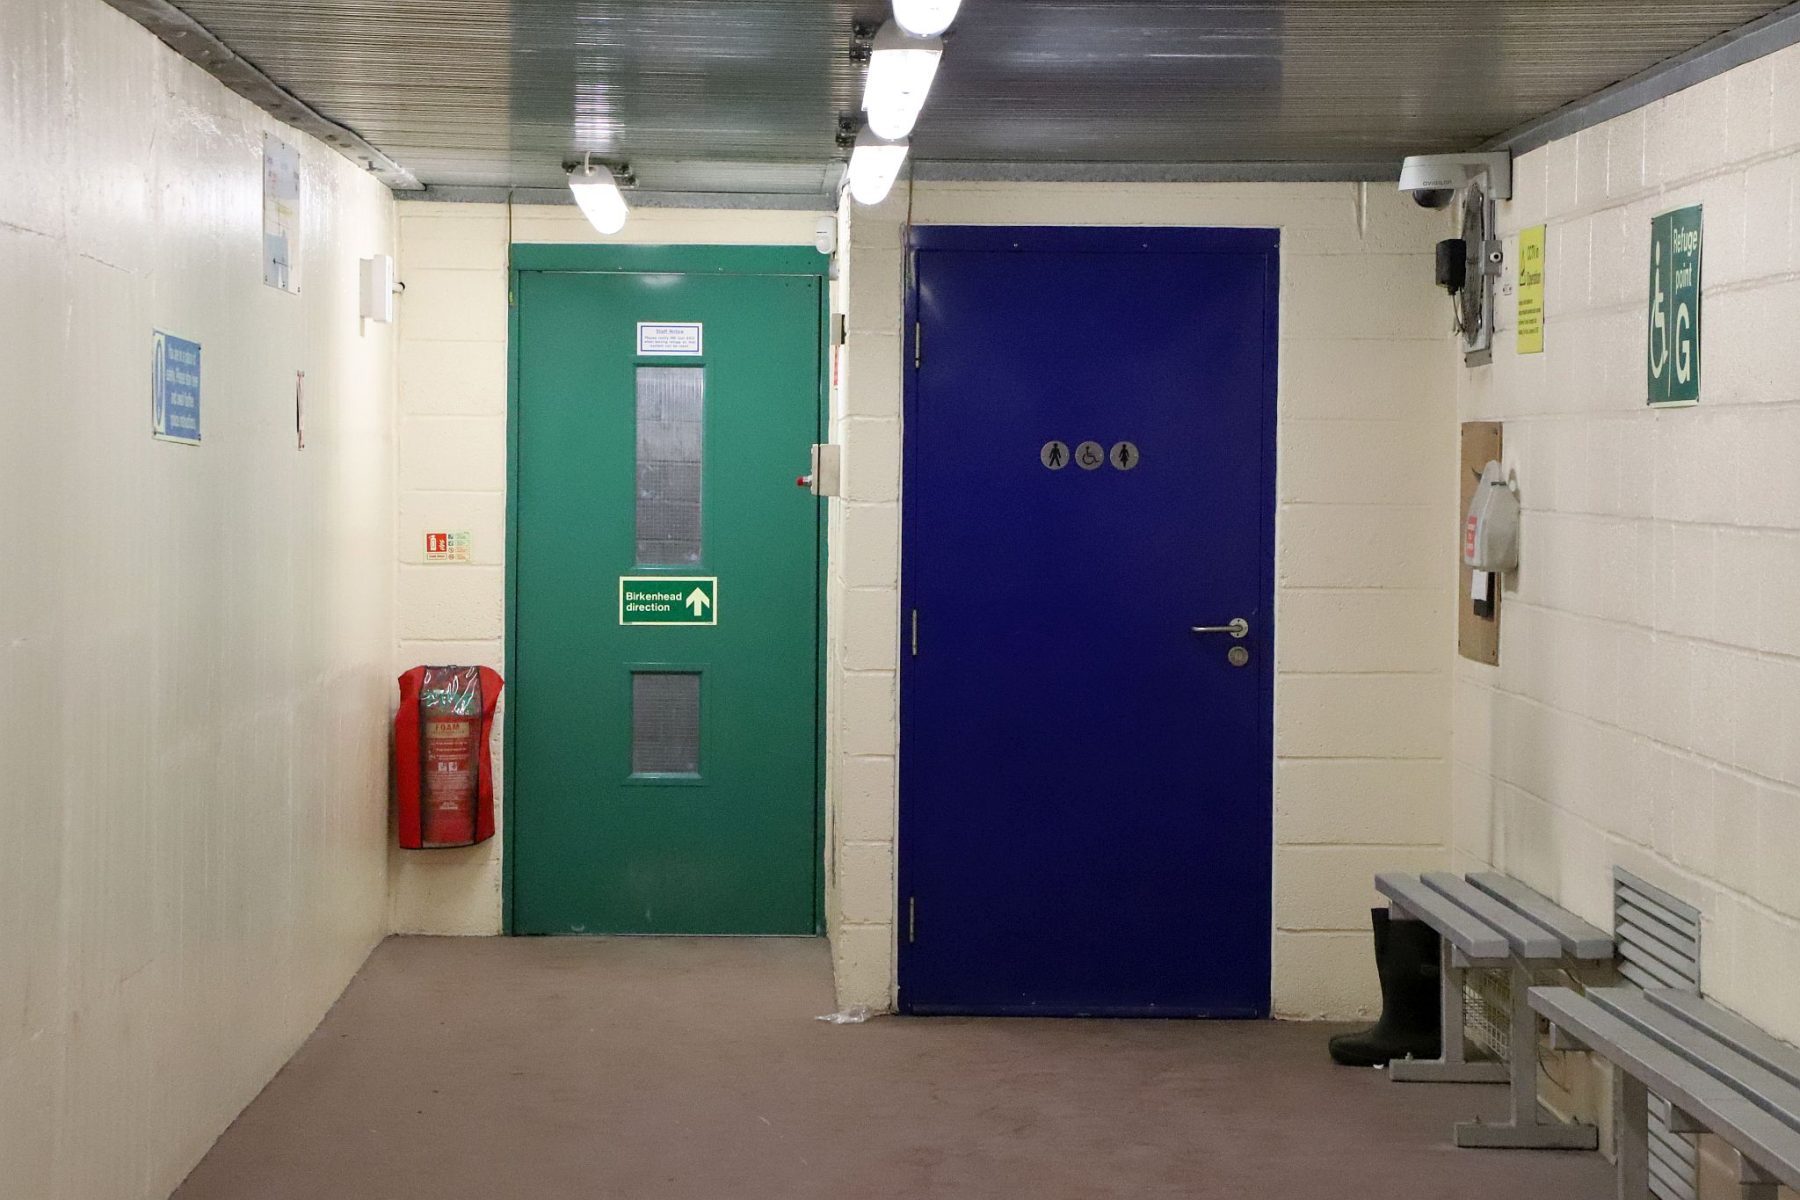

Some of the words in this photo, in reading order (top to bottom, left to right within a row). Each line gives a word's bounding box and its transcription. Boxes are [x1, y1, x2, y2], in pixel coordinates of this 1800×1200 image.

[1673, 228, 1698, 256] Refuge
[1675, 263, 1692, 294] point
[1676, 303, 1690, 384] G
[625, 592, 682, 601] Birkenhead
[626, 603, 670, 611] direction
